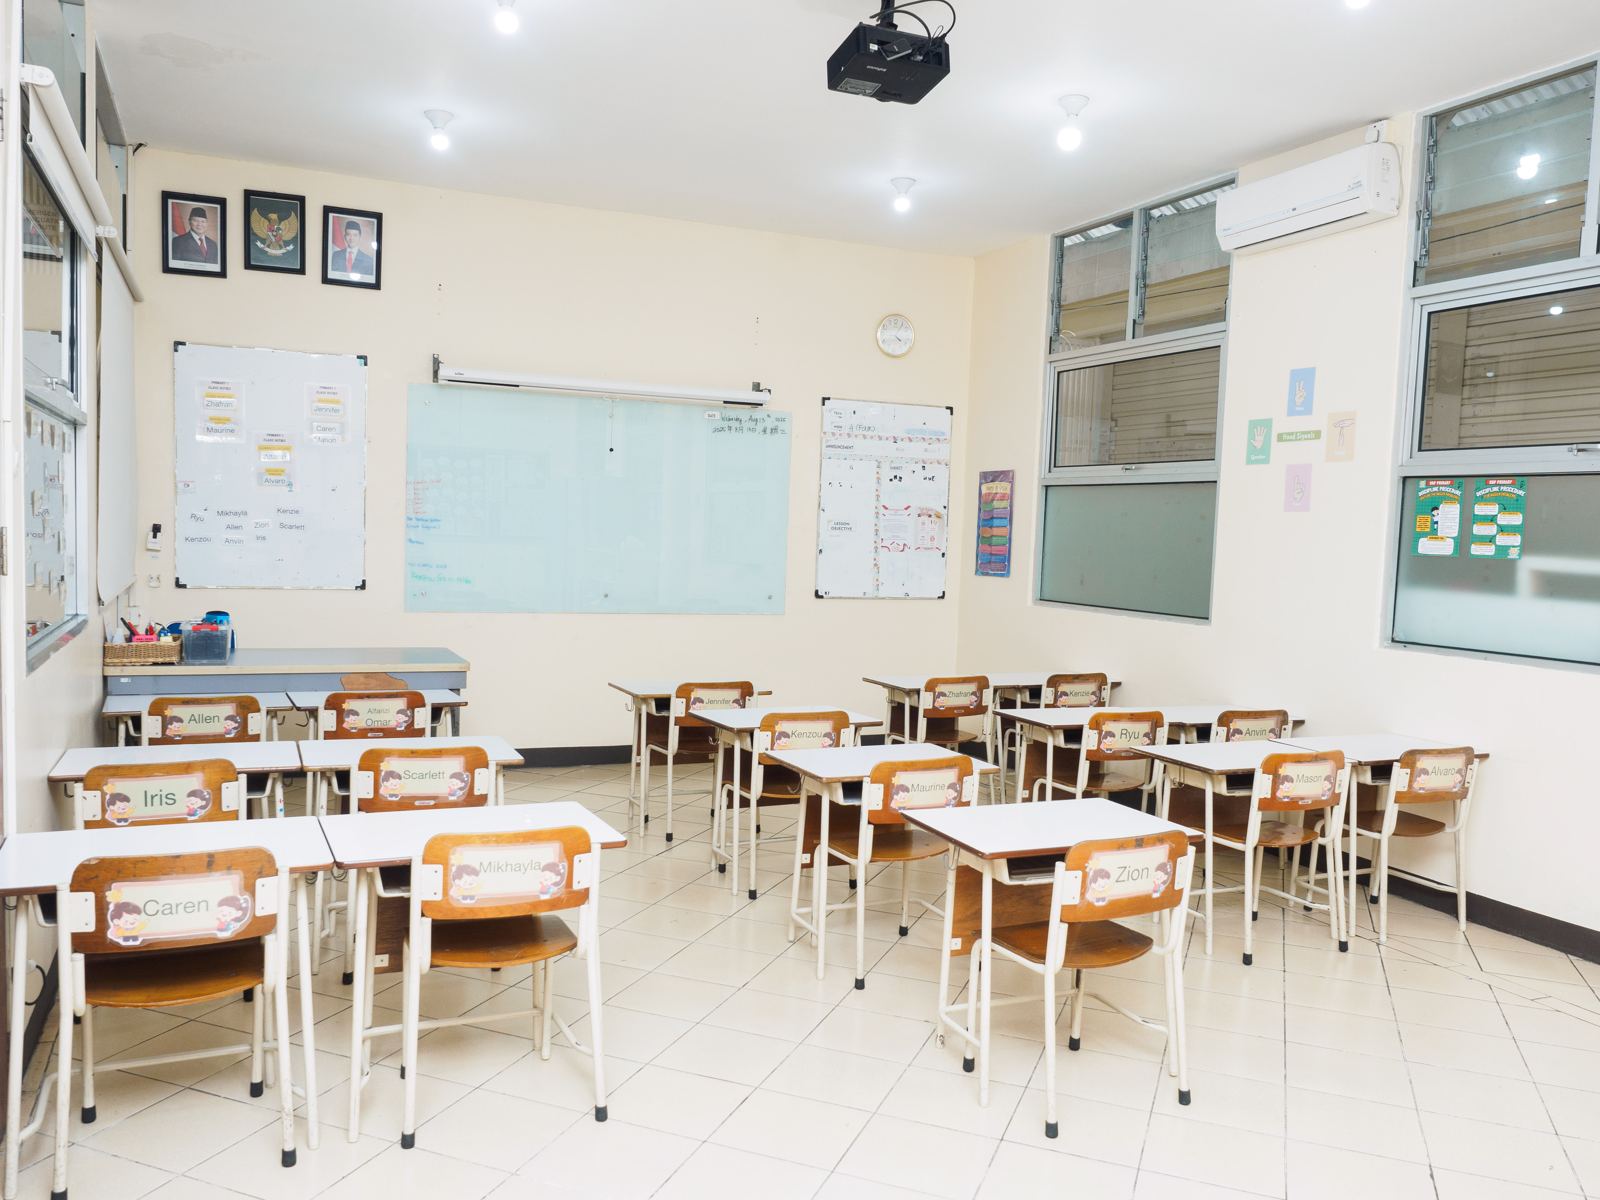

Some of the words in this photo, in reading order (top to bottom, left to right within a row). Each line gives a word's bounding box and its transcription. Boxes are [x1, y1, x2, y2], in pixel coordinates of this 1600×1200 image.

[206, 400, 233, 408] Zhafran
[264, 477, 286, 485] Alvaro
[217, 510, 248, 518] Mikhayla
[276, 507, 300, 515] Kenzie
[190, 513, 204, 522] Ryu
[279, 522, 305, 531] Scarlett
[224, 537, 244, 545] Anvin
[187, 713, 220, 724] Allen
[365, 718, 391, 727] Omar
[790, 729, 822, 739] Kenzou
[1120, 728, 1140, 742] Ryu
[1244, 727, 1267, 737] Anvin
[402, 769, 445, 780] Scarlett
[1430, 765, 1456, 776] Alvaro
[1295, 774, 1322, 784] Mason
[910, 783, 946, 793] Maurine
[143, 789, 177, 808] Iris
[479, 859, 542, 875] Mikhayla
[1115, 866, 1150, 883] Zion
[142, 898, 209, 917] Caren
